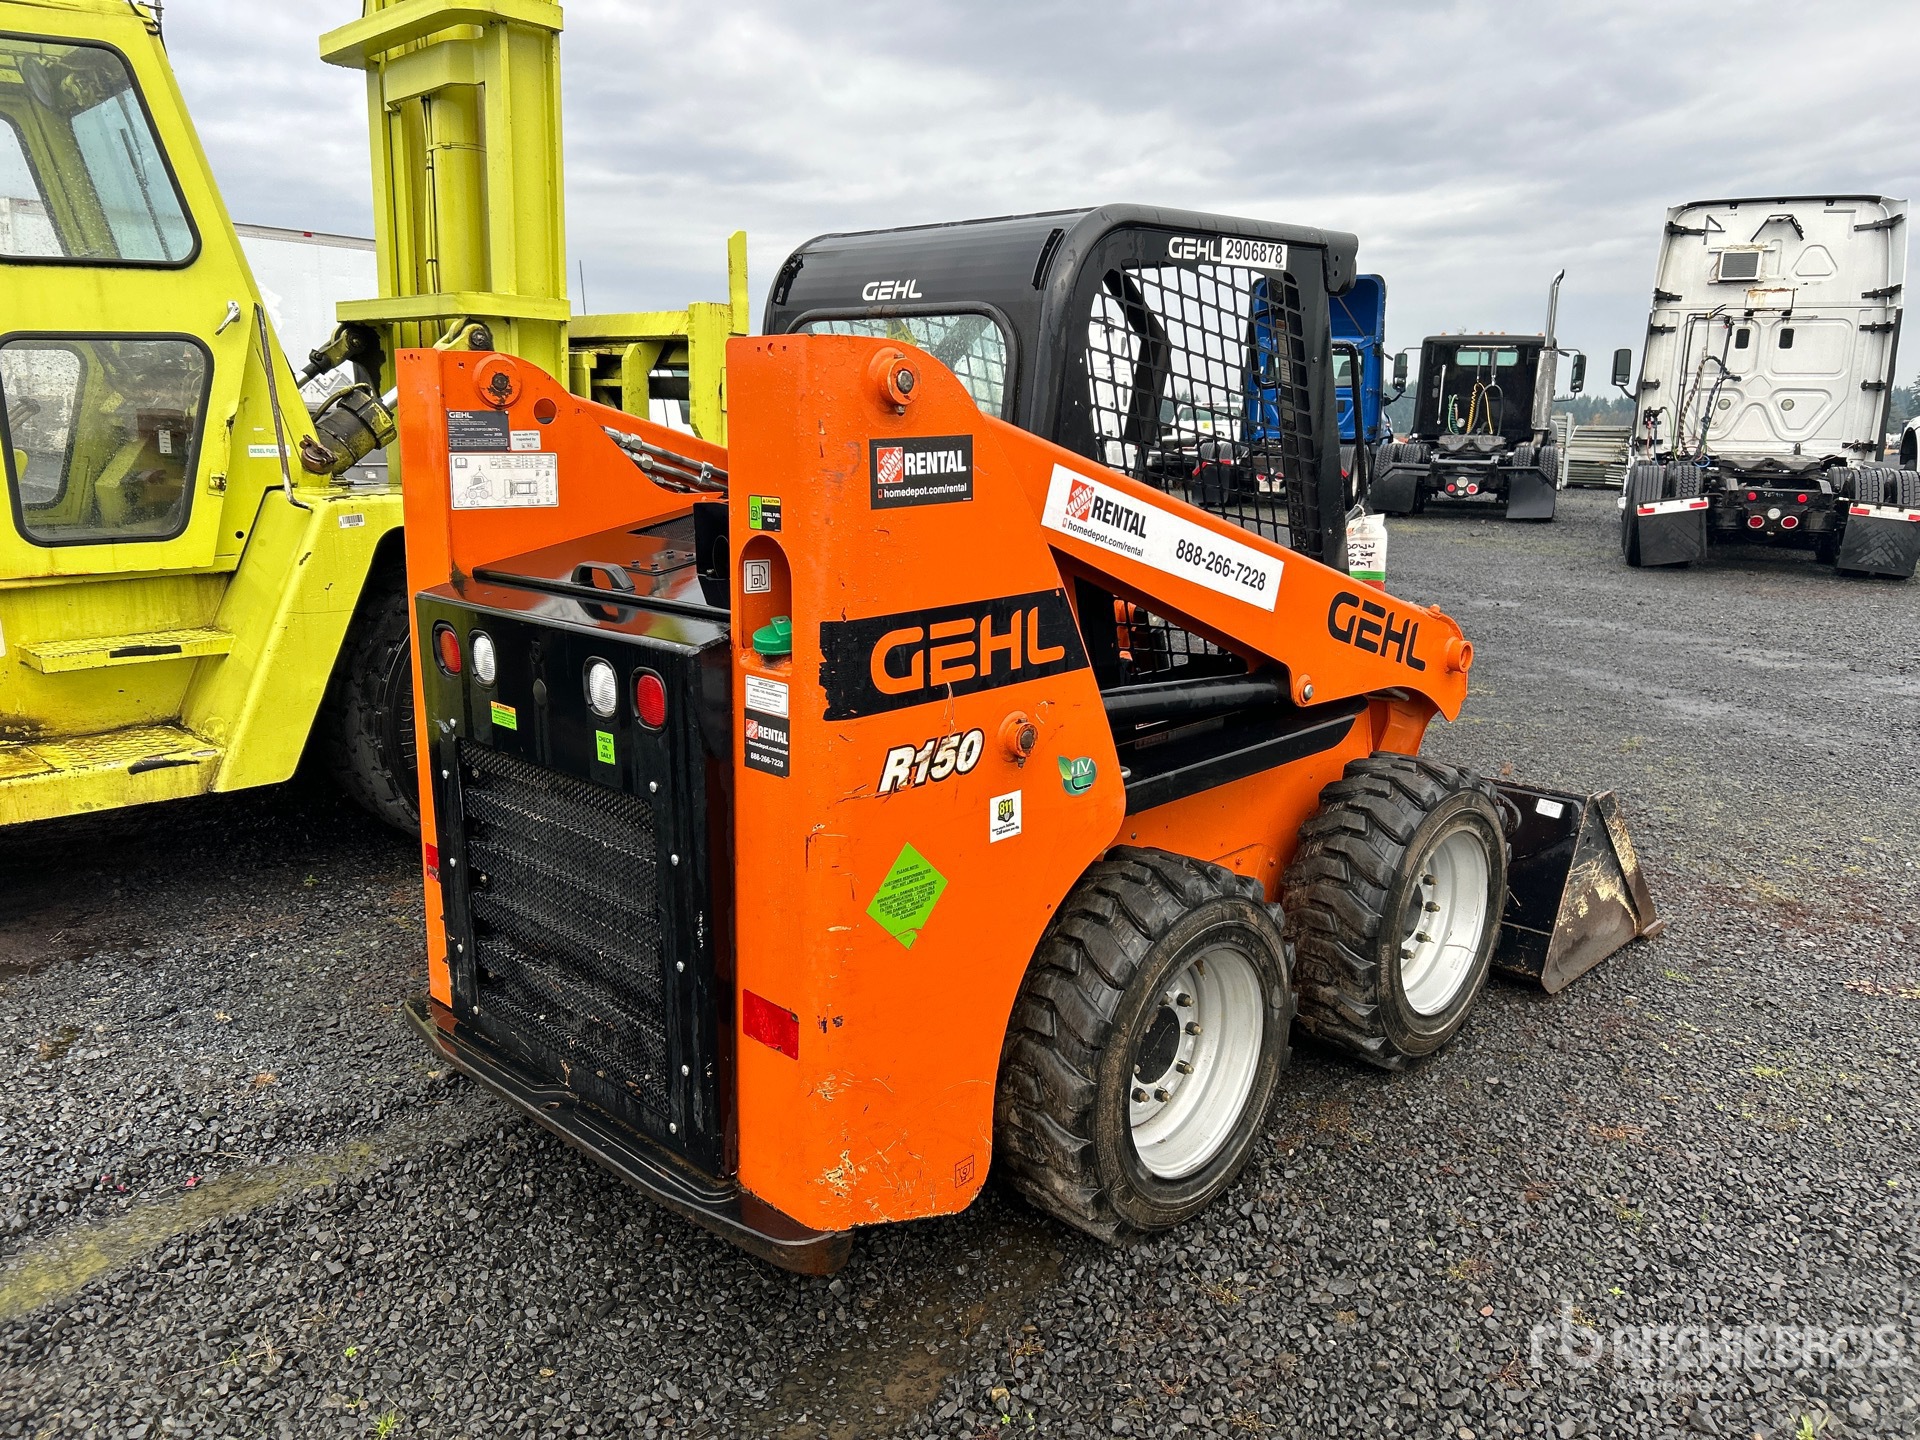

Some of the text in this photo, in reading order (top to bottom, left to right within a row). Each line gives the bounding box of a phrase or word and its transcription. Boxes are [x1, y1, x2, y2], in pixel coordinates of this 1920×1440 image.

[1168, 236, 1283, 264] GEHL 2906878
[862, 279, 922, 301] GEHL
[448, 411, 473, 419] GEHL
[878, 447, 903, 483] HOME
[904, 450, 967, 476] RENTAL
[884, 483, 967, 498] homedepot.com/rental
[1066, 486, 1095, 517] HOME
[1071, 485, 1084, 498] THE
[1091, 495, 1147, 539] RENTAL
[1068, 520, 1144, 557] homedepot.com/rental
[1176, 538, 1266, 591] 888-266-7228
[1327, 591, 1426, 672] GEHL
[870, 606, 1066, 696] GEHL
[598, 736, 612, 744] CHECK
[758, 725, 788, 745] RENTAL
[600, 751, 612, 760] DAILY
[750, 752, 784, 768] 888-266-7228
[877, 728, 984, 796] R150
[999, 800, 1012, 816] 811
